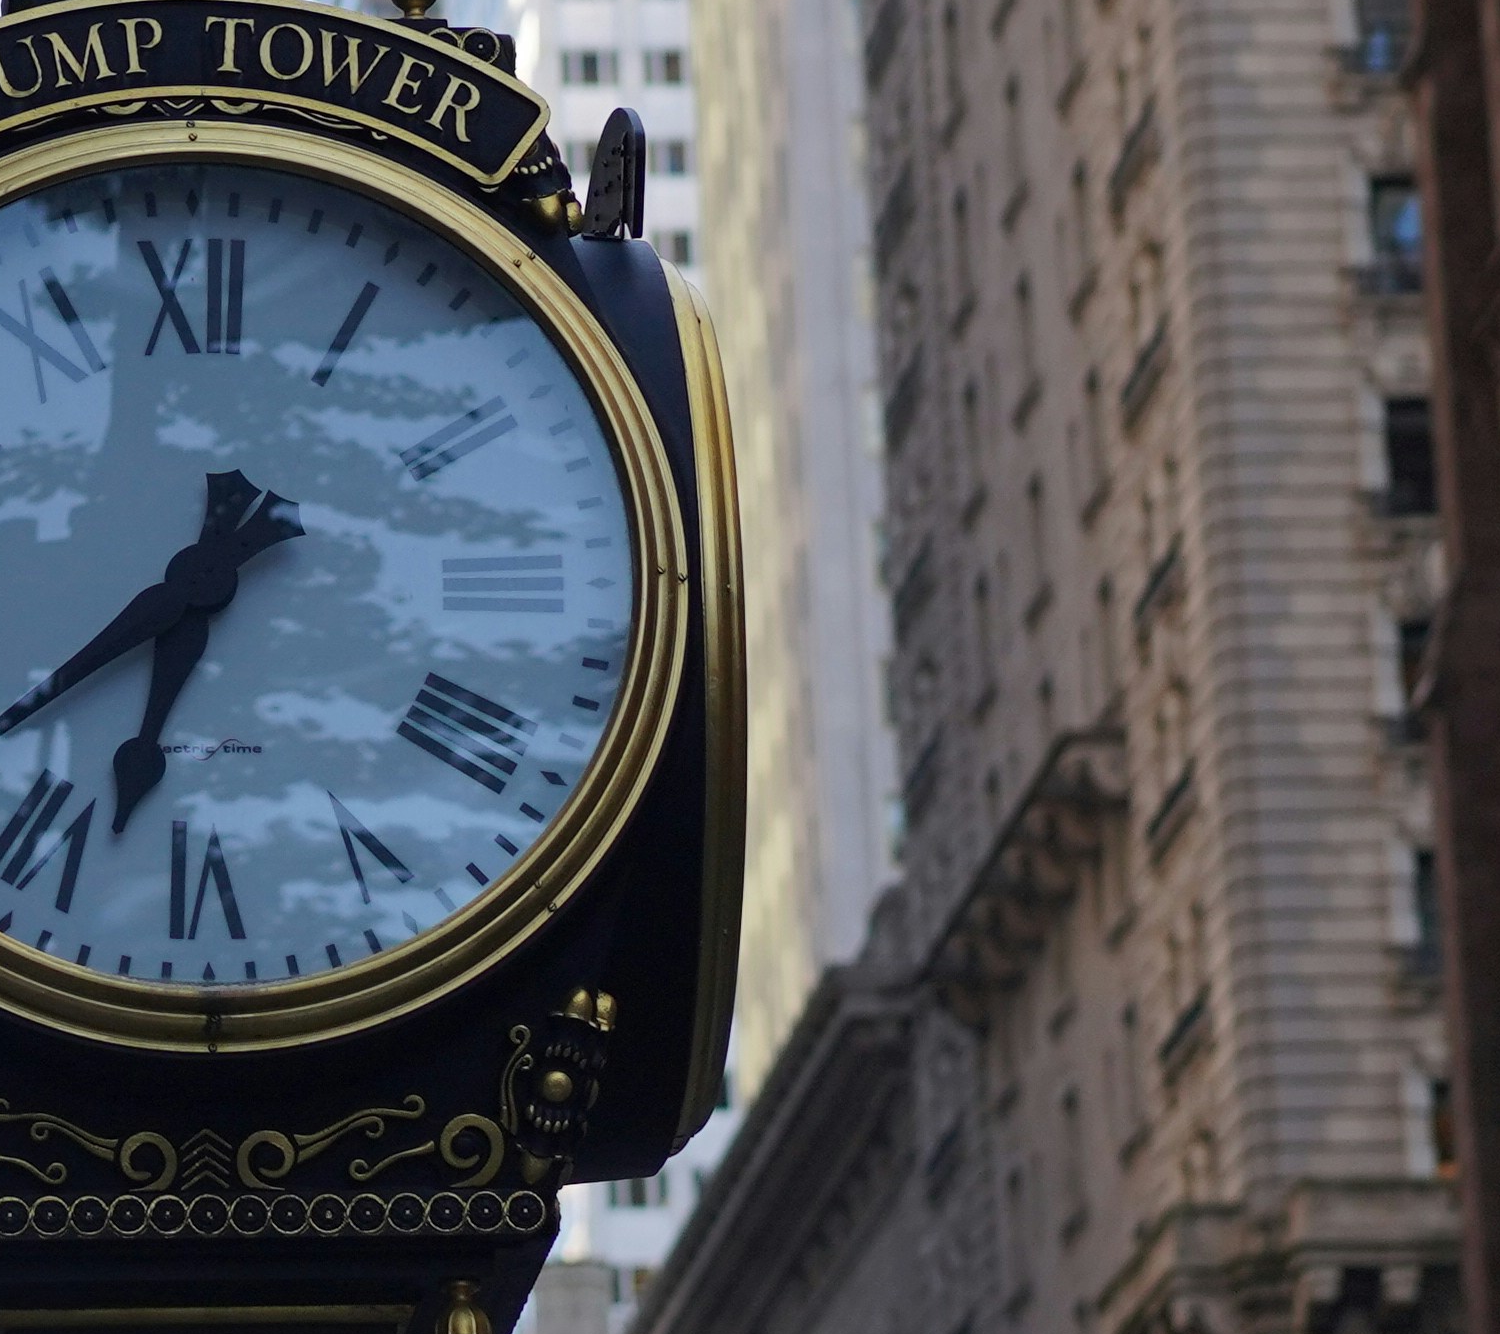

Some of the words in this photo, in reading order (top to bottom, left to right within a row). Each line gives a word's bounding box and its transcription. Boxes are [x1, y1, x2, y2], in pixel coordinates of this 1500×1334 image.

[204, 15, 482, 143] TOWER
[137, 238, 245, 356] XII
[311, 281, 380, 387] I
[399, 395, 518, 482] II
[442, 554, 564, 613] III
[163, 743, 215, 755] ectric
[223, 743, 262, 755] time
[396, 671, 538, 795] IIII
[169, 821, 247, 940] VI
[326, 790, 414, 904] V
